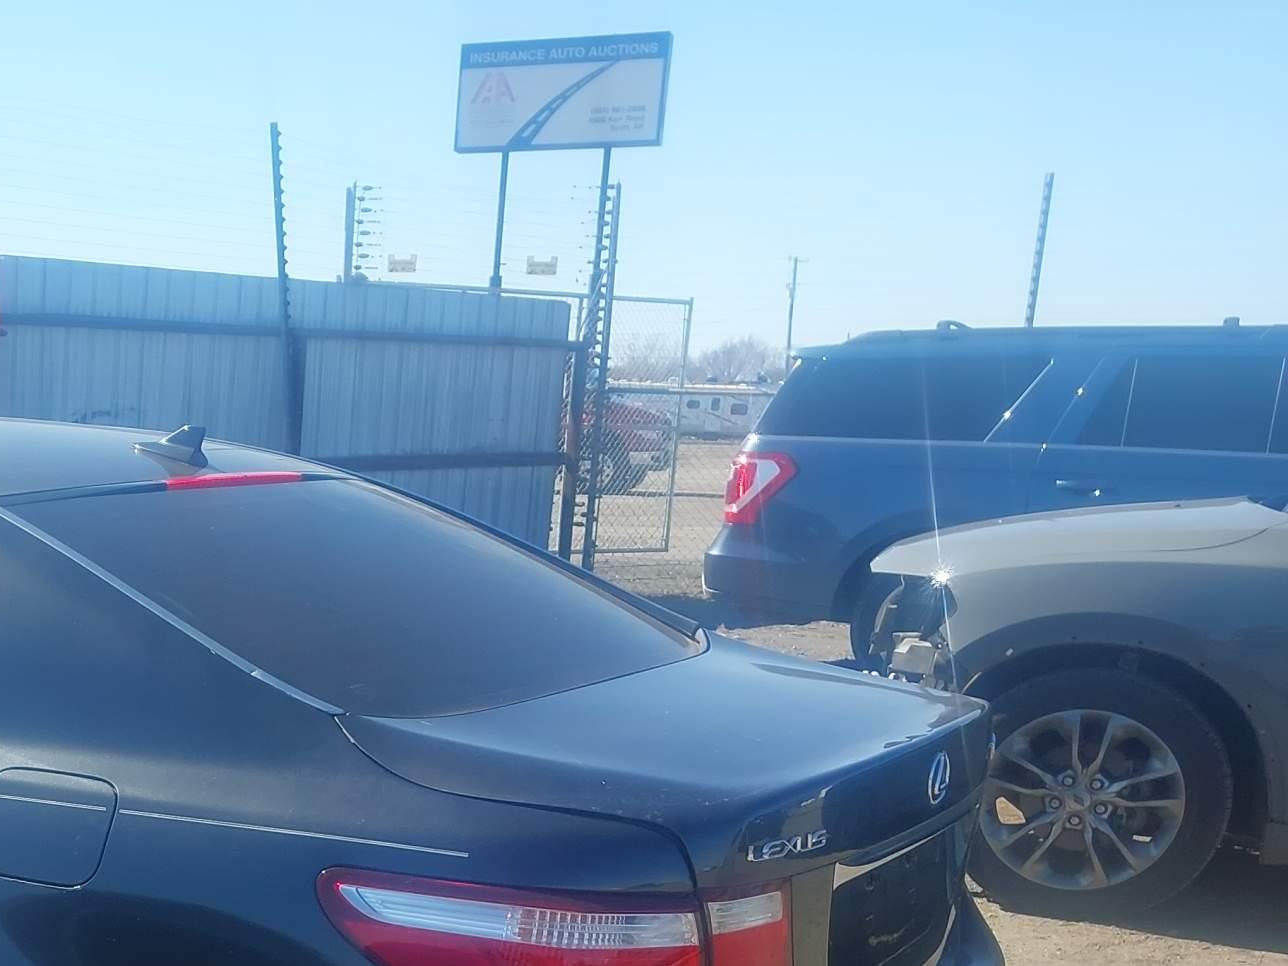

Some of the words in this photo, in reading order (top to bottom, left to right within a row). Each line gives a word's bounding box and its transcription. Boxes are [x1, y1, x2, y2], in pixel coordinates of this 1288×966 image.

[469, 48, 545, 65] INSURANCE
[549, 47, 585, 59] AUTO
[588, 42, 658, 57] AUCTIONS
[746, 829, 829, 863] LEXUS
